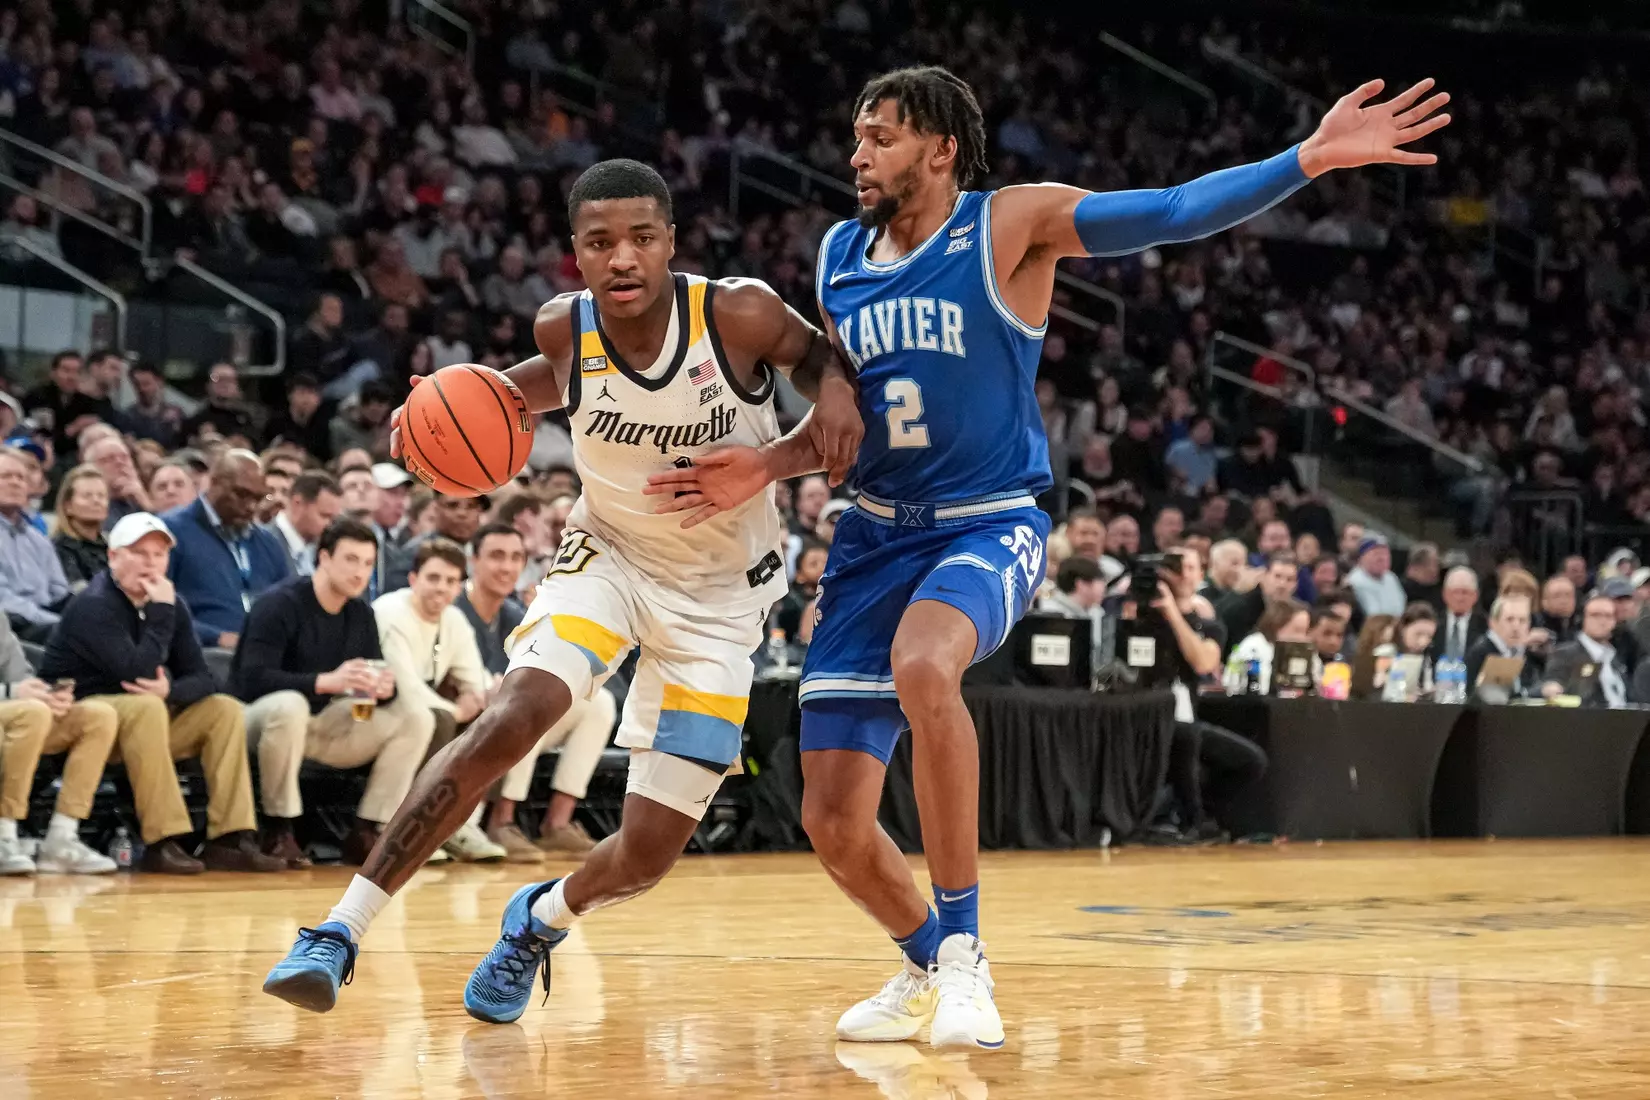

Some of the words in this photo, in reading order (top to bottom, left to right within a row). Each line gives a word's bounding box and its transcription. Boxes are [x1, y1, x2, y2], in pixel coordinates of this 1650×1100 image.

[945, 241, 974, 252] EAST
[948, 236, 968, 247] BIG
[836, 296, 967, 373] XAVIER
[699, 385, 724, 403] EAST
[700, 382, 717, 396] BIG
[884, 377, 932, 450] 2
[584, 402, 737, 455] Marquette
